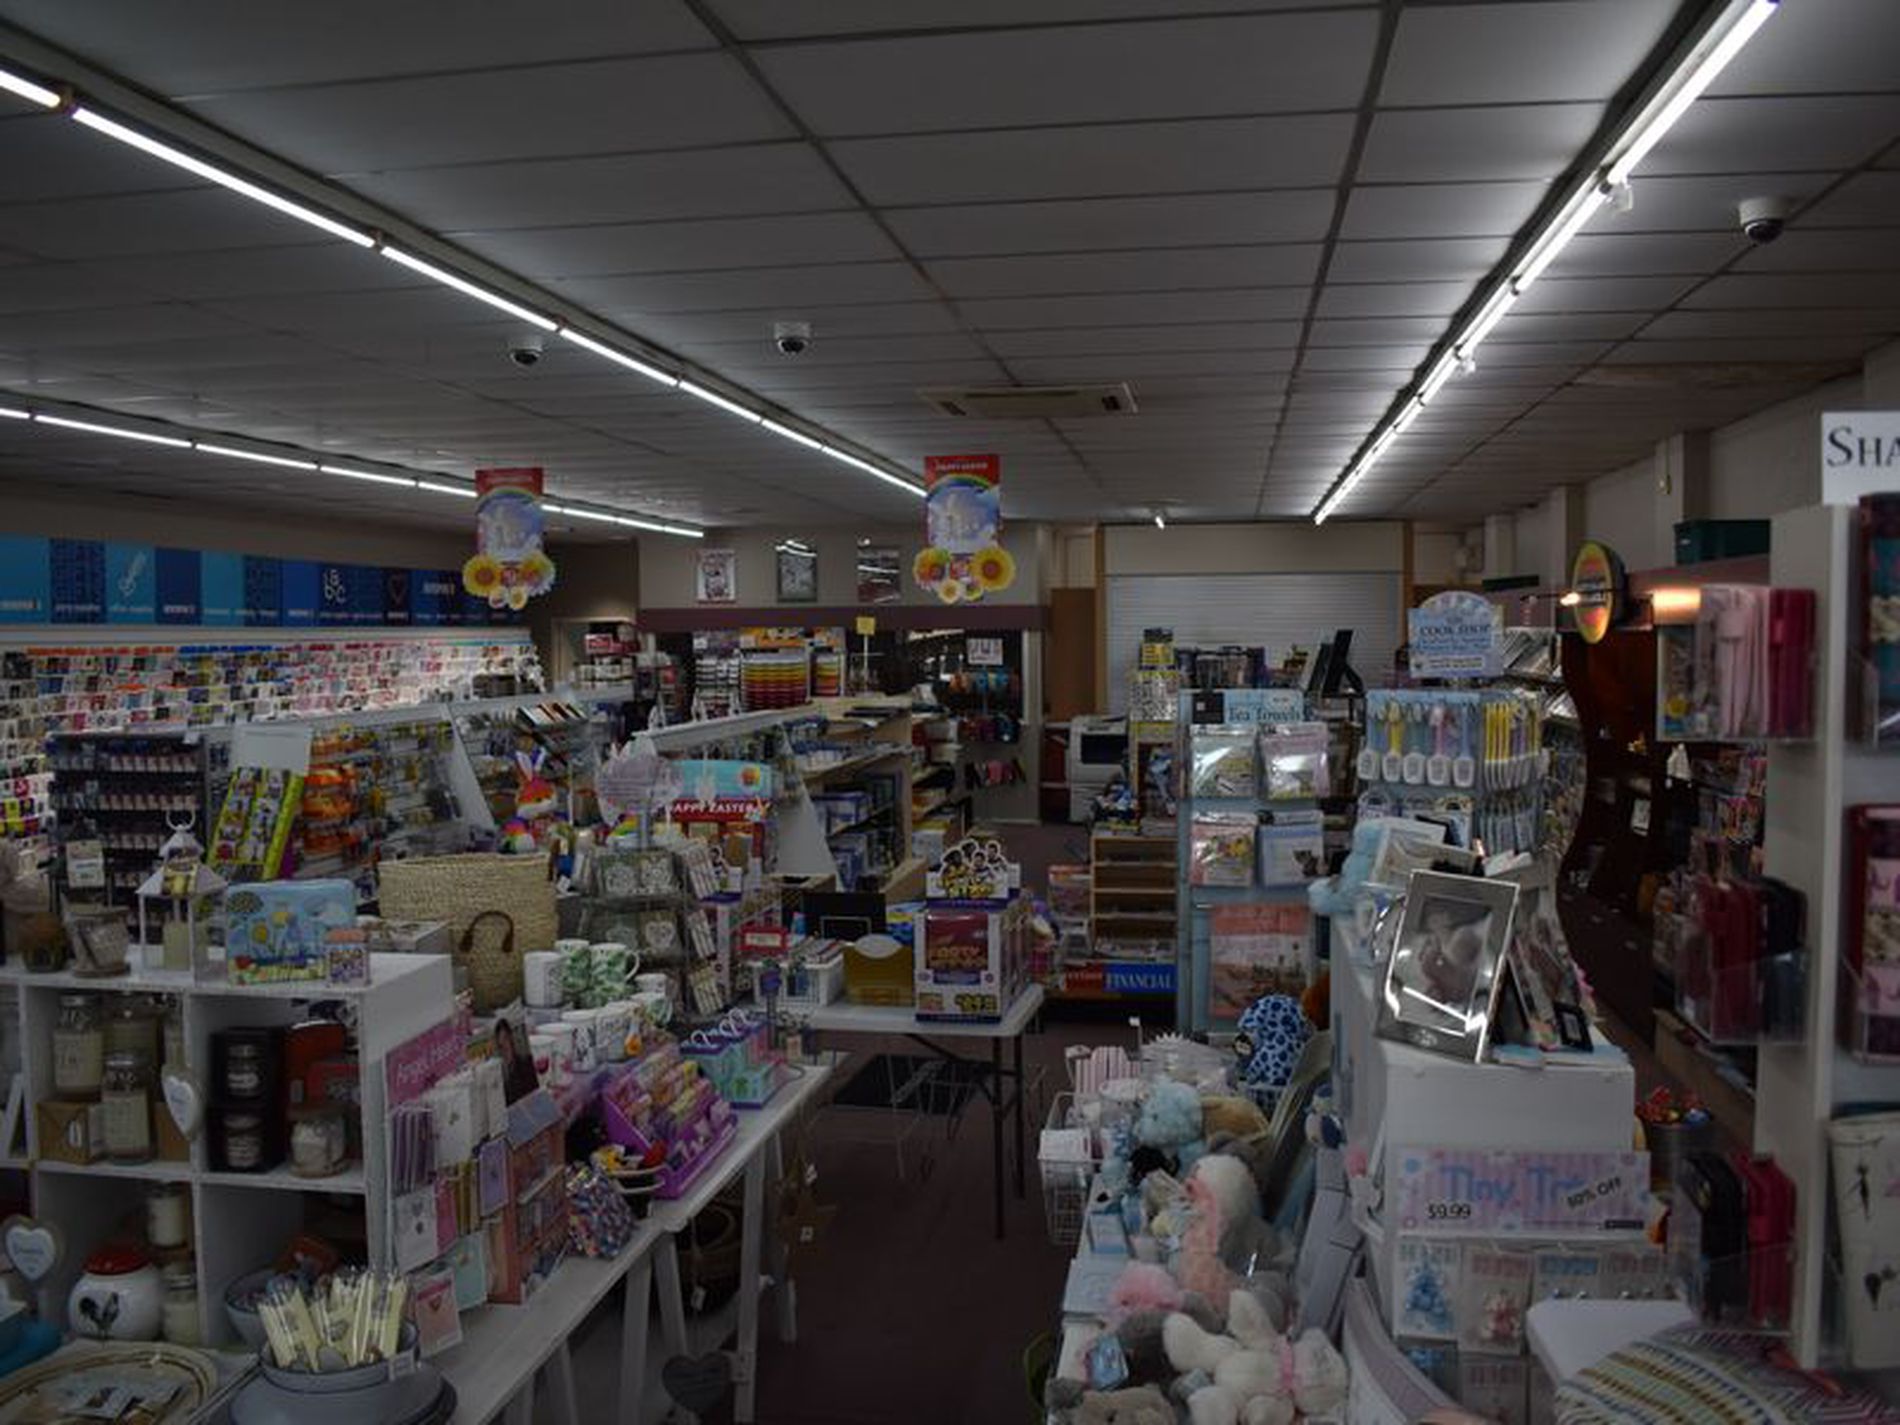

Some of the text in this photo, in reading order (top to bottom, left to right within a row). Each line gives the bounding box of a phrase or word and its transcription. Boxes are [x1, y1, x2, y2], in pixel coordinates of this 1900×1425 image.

[1104, 971, 1171, 990] FINANCIAL
[1440, 1164, 1516, 1207] Tiny
[1427, 1202, 1472, 1220] $9.99
